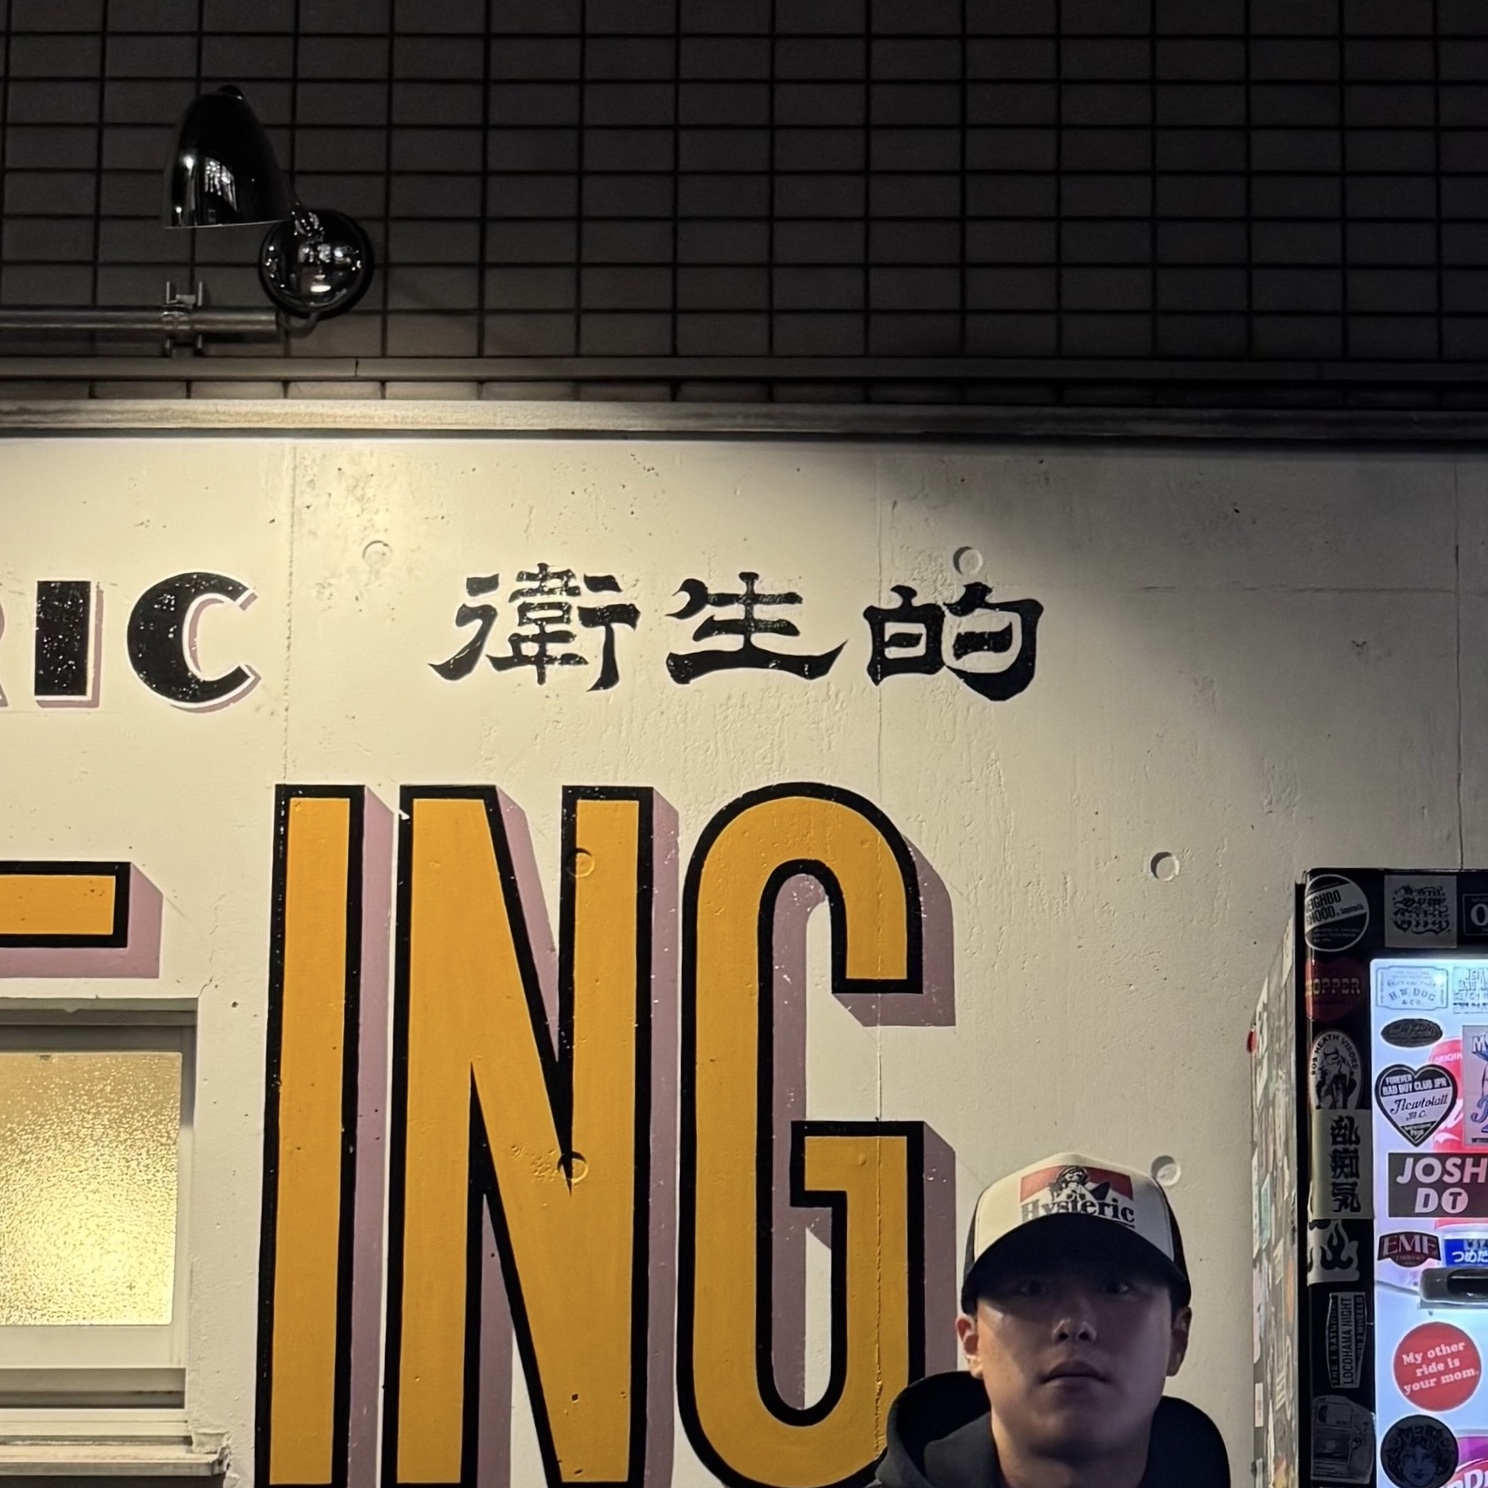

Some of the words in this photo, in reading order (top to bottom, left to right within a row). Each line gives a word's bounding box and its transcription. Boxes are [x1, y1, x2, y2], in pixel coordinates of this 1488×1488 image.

[0, 572, 256, 706] IC
[428, 563, 1044, 702] 衛生的
[1396, 1157, 1488, 1184] JOSH
[1402, 1351, 1423, 1366] My
[1427, 1341, 1466, 1360] other
[1415, 1360, 1445, 1378] ride
[1448, 1357, 1460, 1370] is
[1403, 1377, 1438, 1396] your
[1440, 1367, 1480, 1385] mom.
